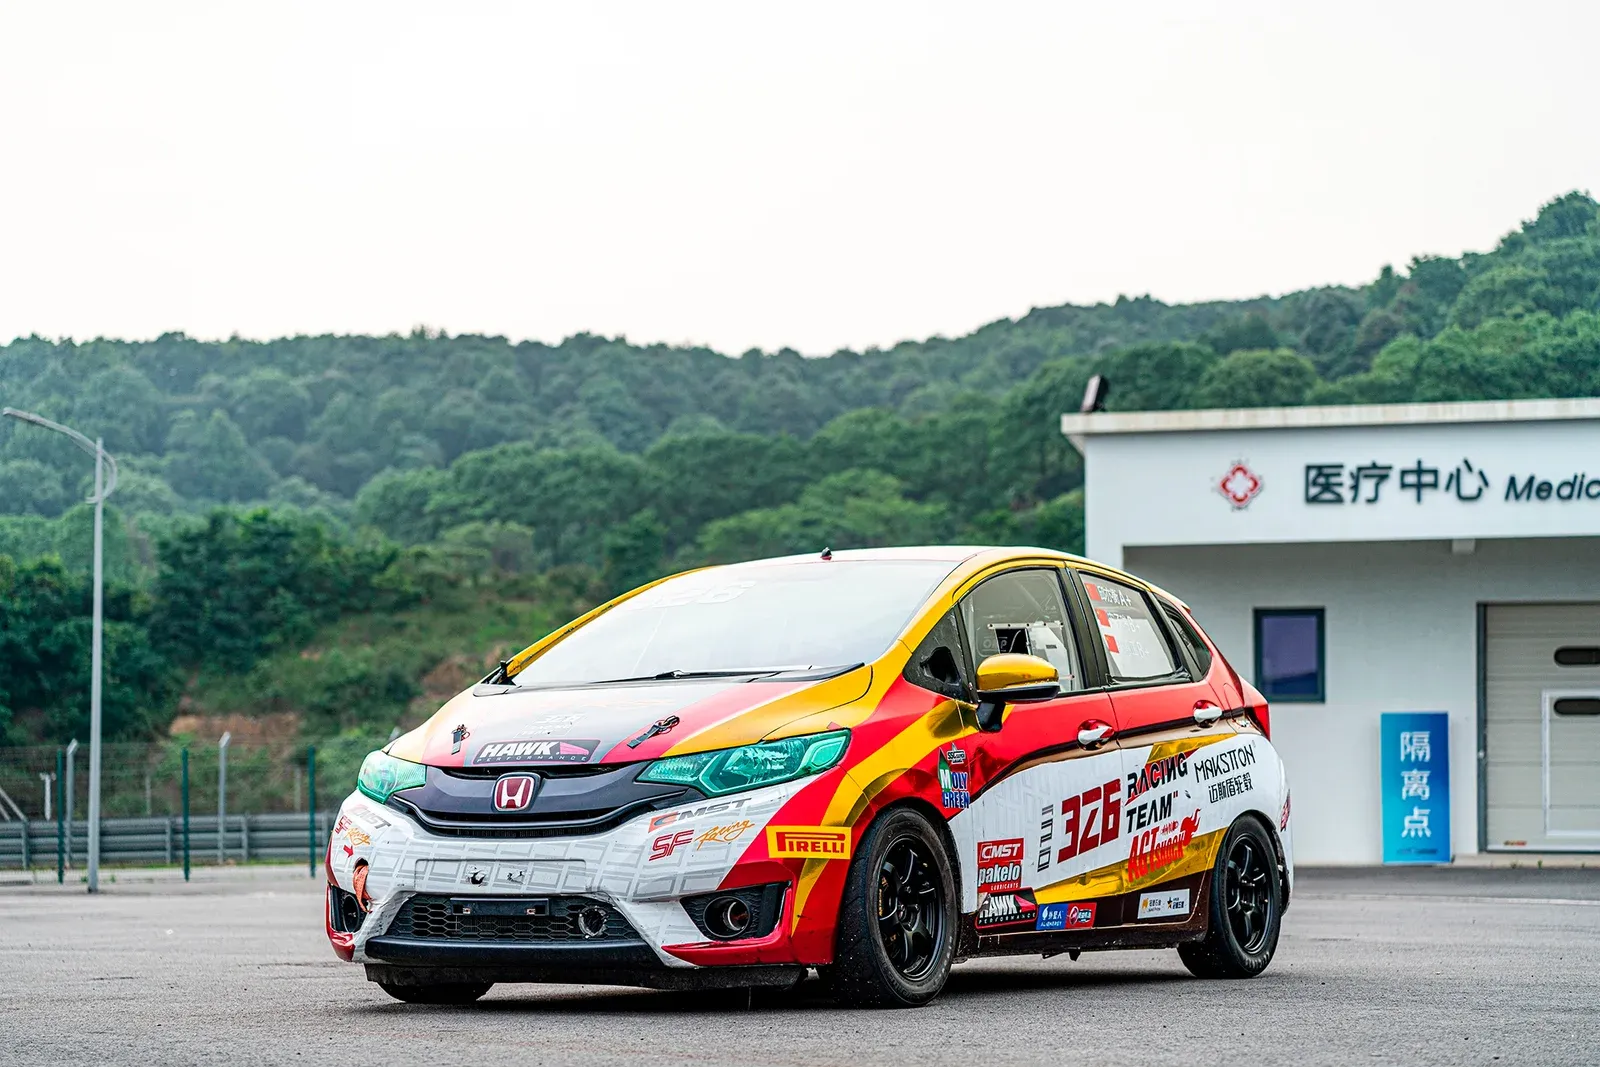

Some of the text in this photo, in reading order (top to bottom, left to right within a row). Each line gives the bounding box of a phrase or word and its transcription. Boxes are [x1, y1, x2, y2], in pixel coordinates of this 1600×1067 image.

[1304, 459, 1489, 505] 医疗中心
[476, 755, 588, 763] PERFORMANCE
[479, 741, 559, 758] HAWK
[940, 769, 968, 790] MOLY
[1127, 752, 1188, 800] RACING
[1208, 772, 1253, 803] 迈斯盾轮毂
[1400, 731, 1432, 838] 隔离点
[942, 791, 970, 808] GREEN
[652, 798, 752, 825] CMST
[1057, 778, 1121, 864] 326
[649, 819, 755, 861] SF Racing
[776, 831, 846, 854] PIRELLI
[981, 843, 1021, 861] CMST
[978, 863, 1020, 886] pakelo
[978, 912, 1036, 925] PERFORMANCE
